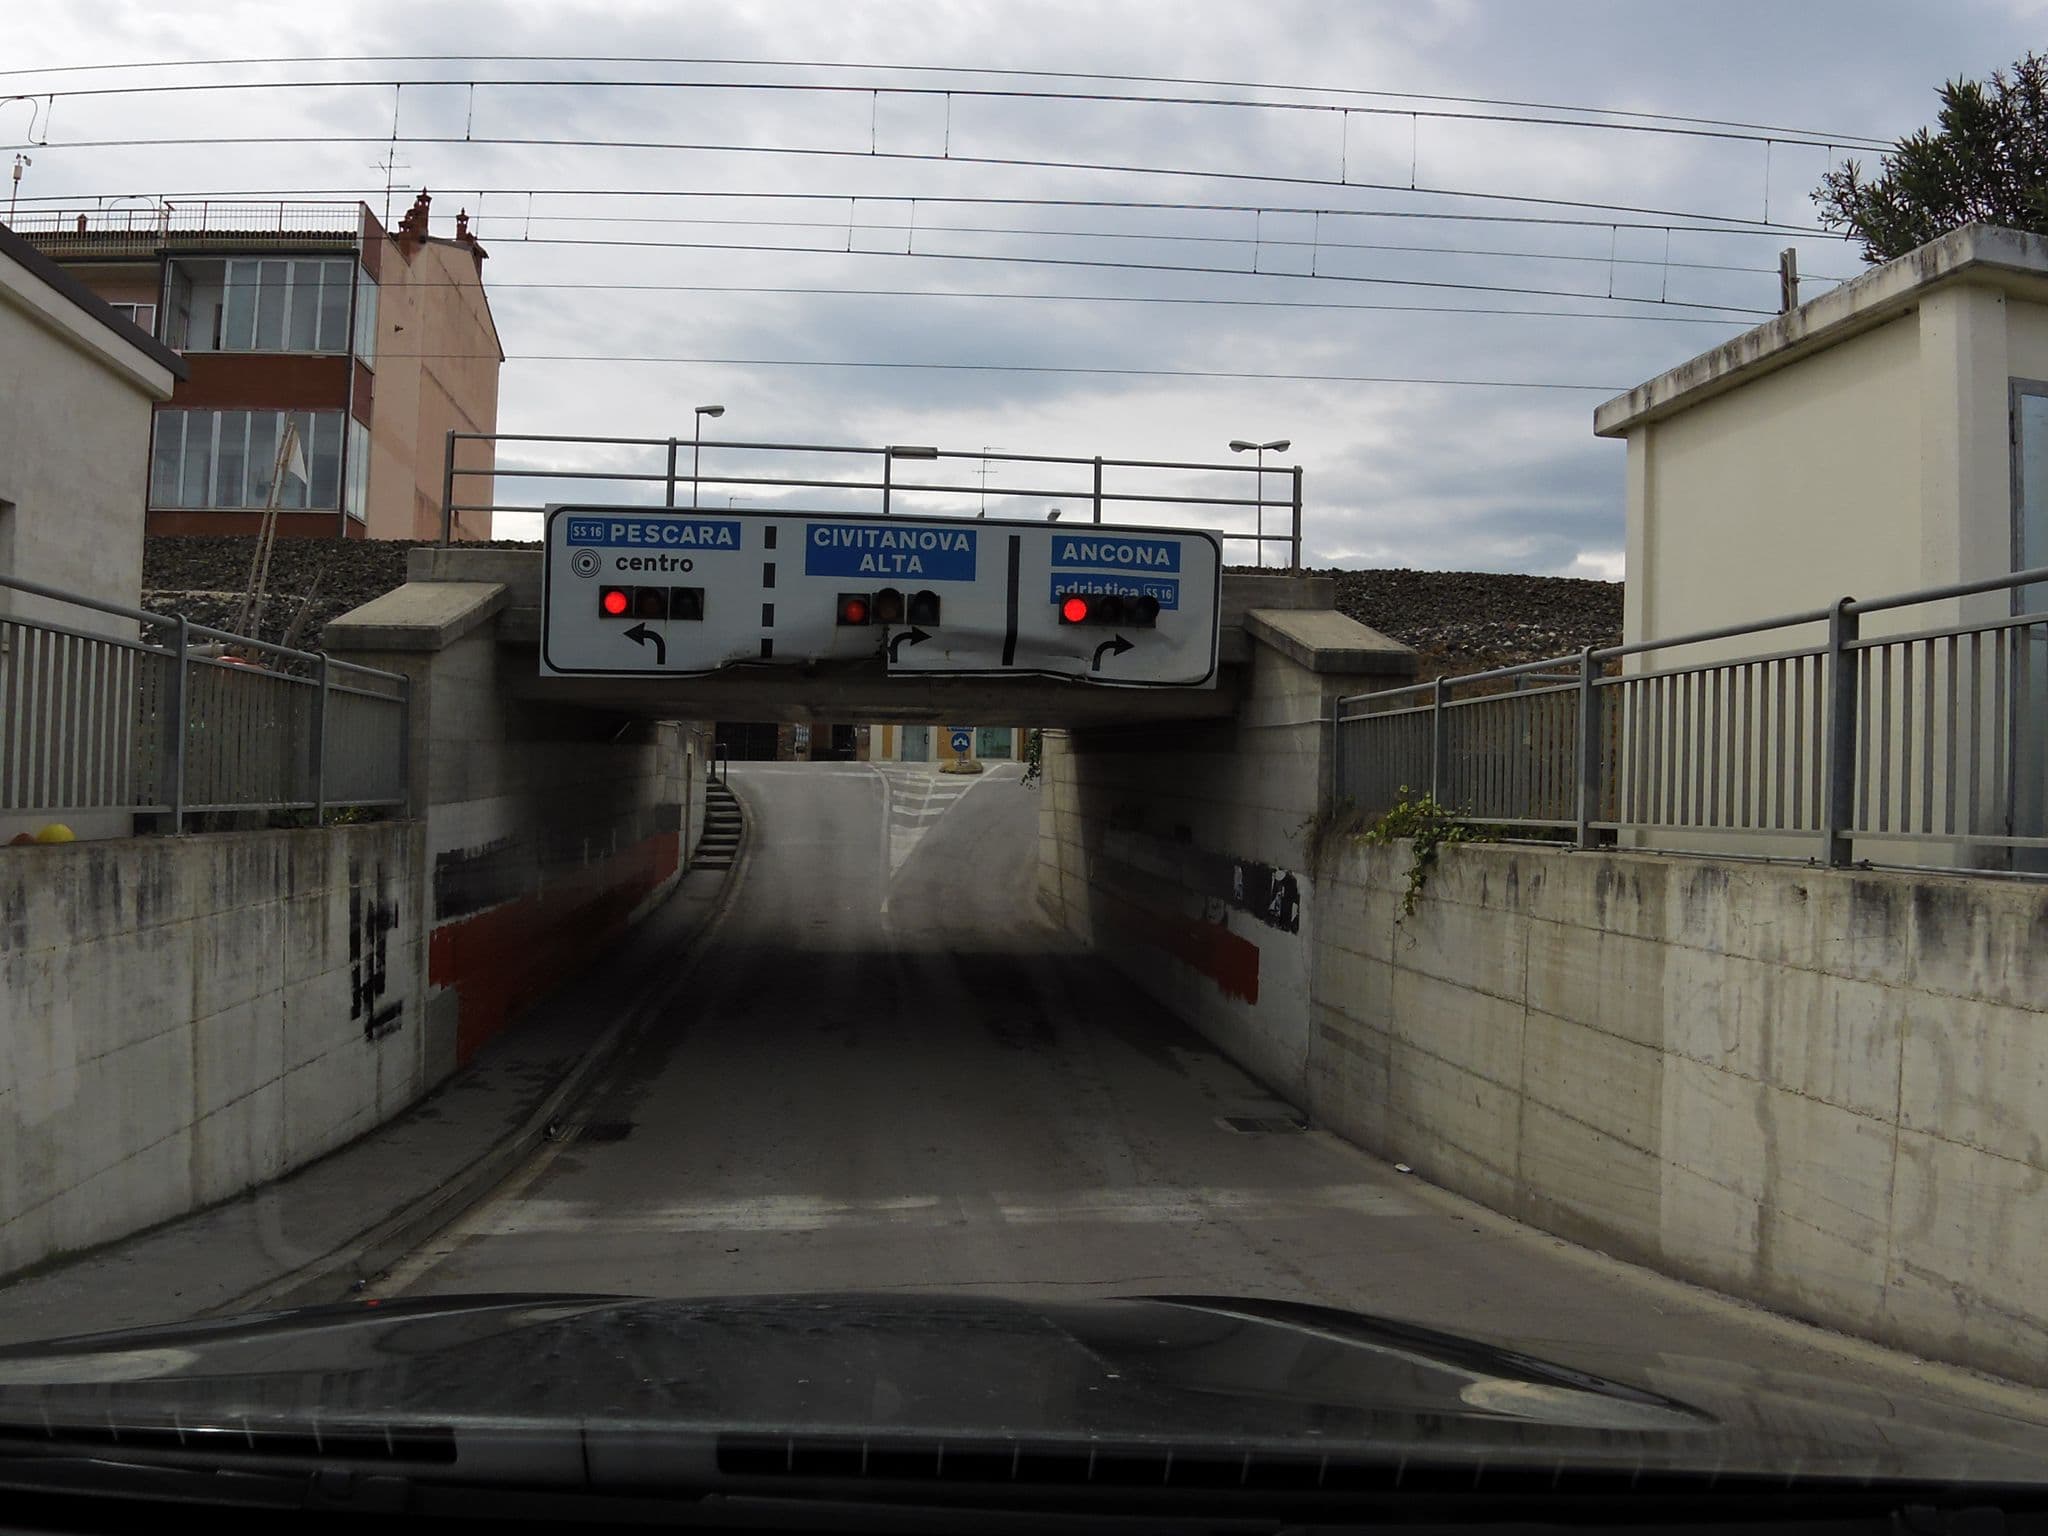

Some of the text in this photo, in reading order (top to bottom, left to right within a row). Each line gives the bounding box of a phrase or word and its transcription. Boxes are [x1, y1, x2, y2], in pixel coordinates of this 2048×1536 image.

[573, 522, 733, 545] SS 16 PESCARA
[813, 527, 970, 552] CIVITANOVA
[615, 553, 694, 573] centro
[859, 553, 923, 574] ALTA
[1062, 542, 1171, 566] ANCONA
[1161, 588, 1172, 600] 16
